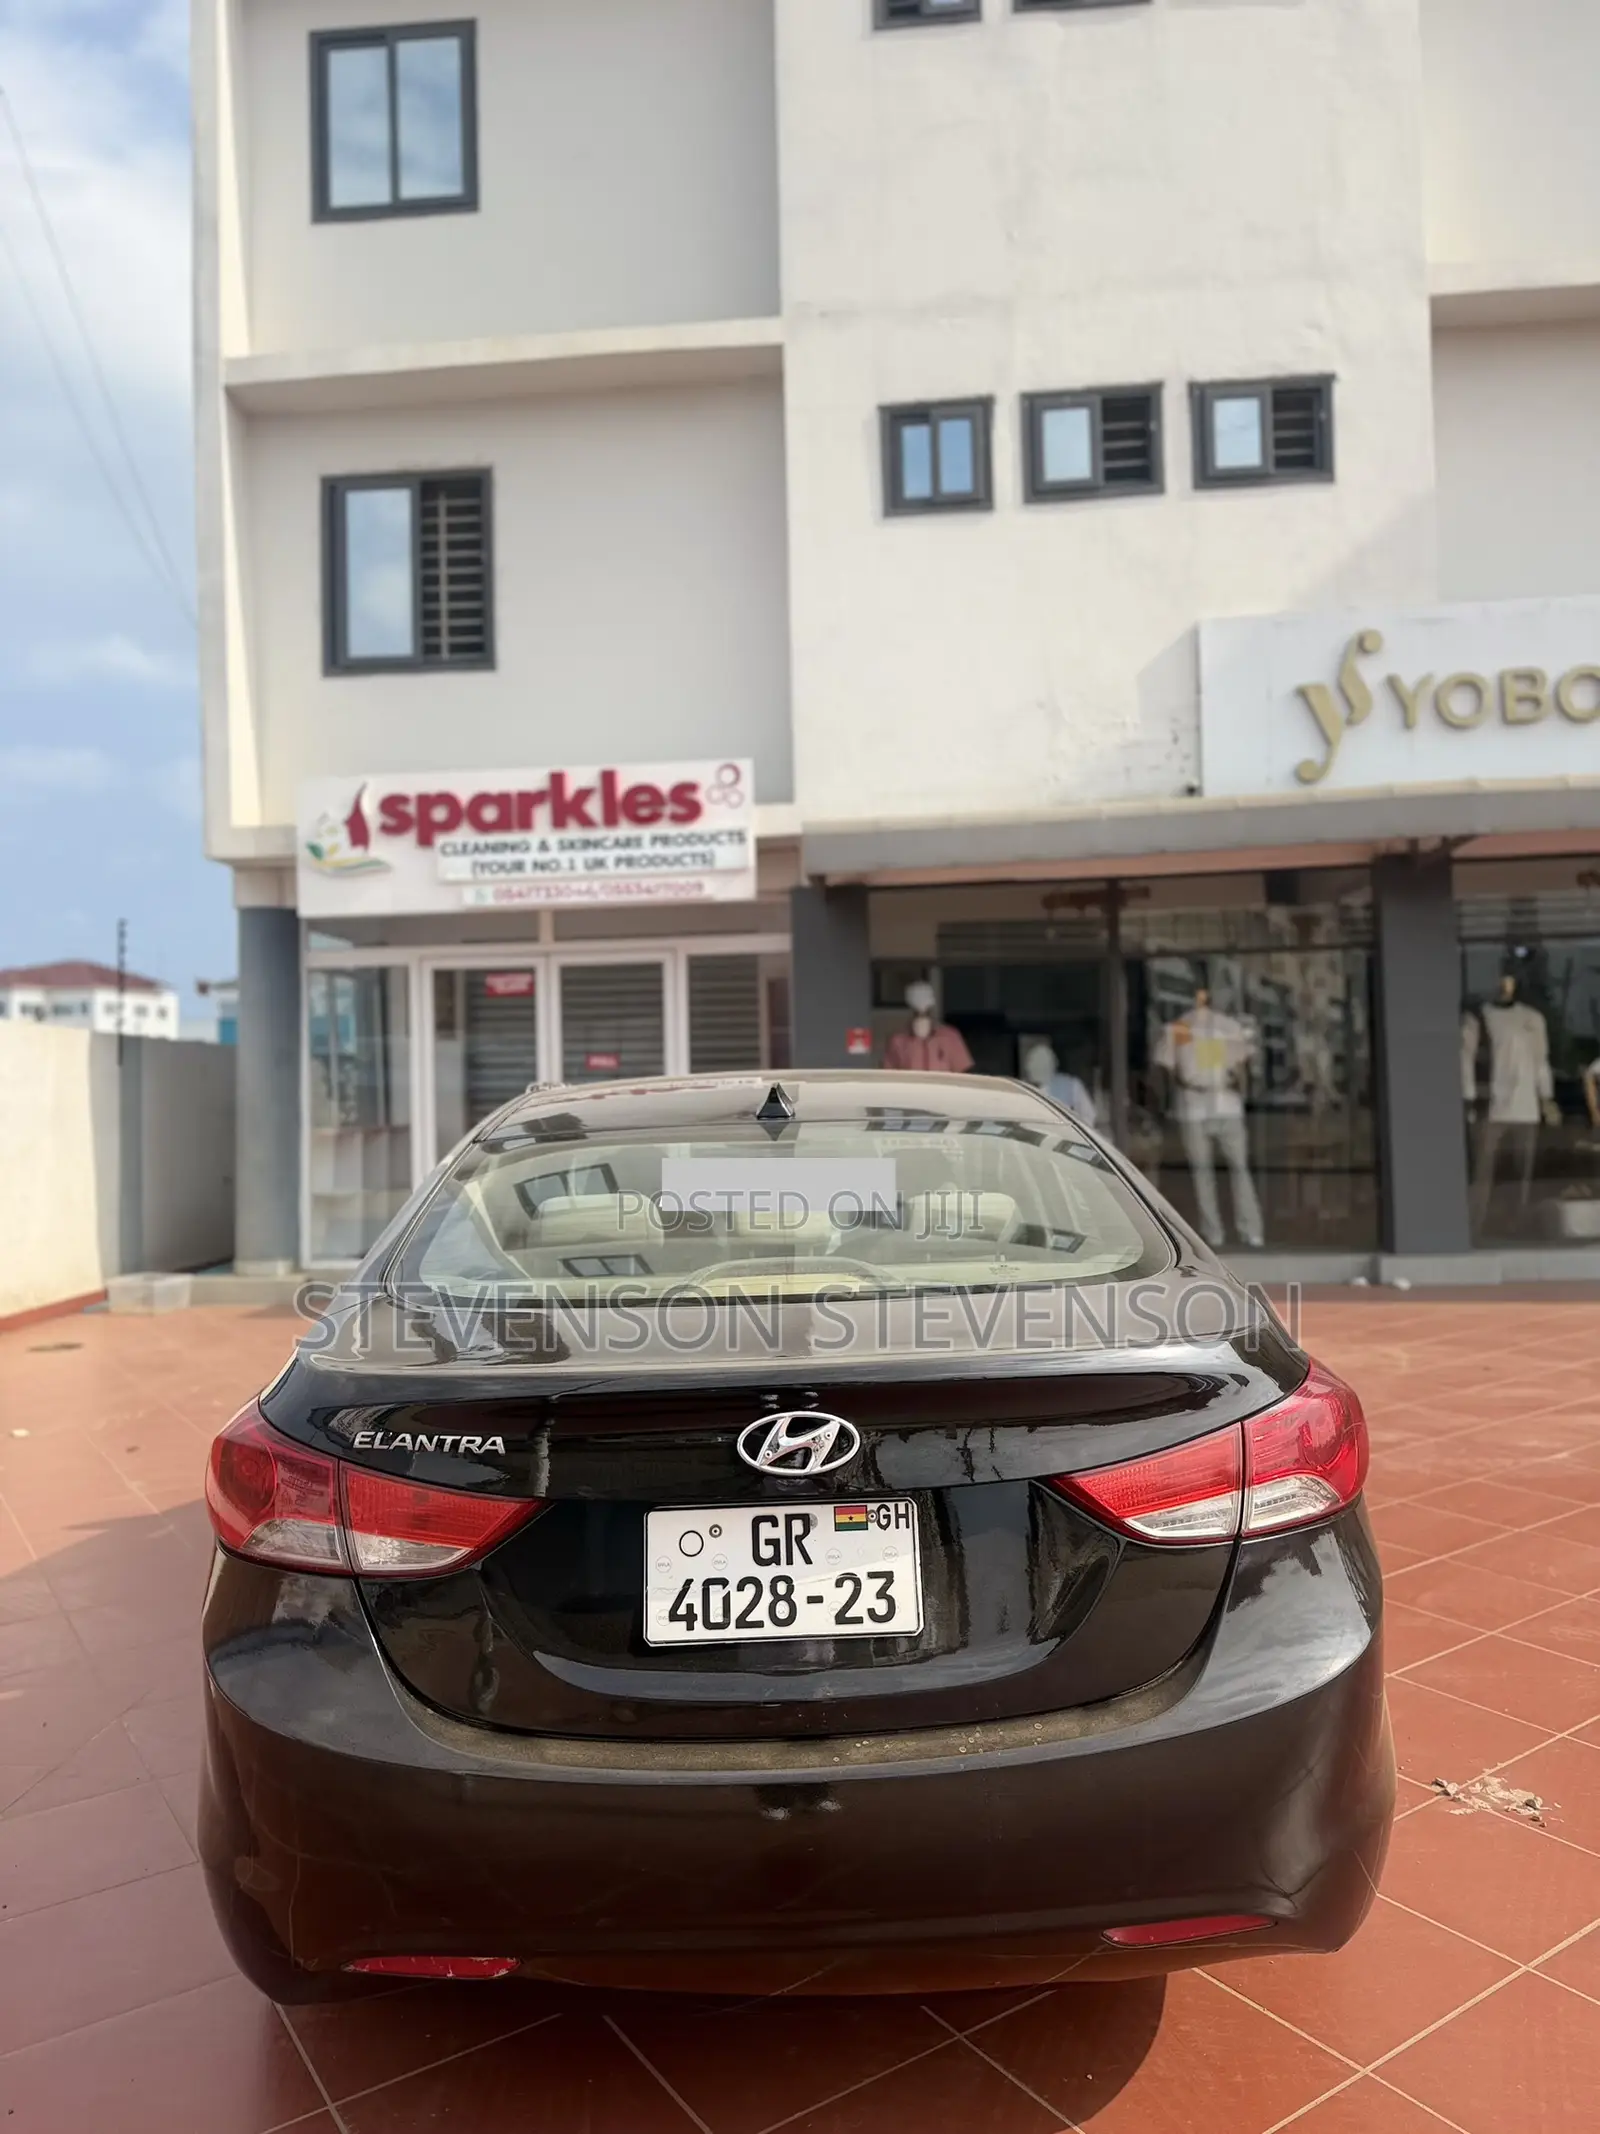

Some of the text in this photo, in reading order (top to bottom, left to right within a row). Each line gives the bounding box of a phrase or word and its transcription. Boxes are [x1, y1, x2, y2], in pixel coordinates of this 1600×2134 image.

[378, 769, 704, 847] sparkles
[439, 829, 746, 856] CLEANING & SKINCARE PRODUCTS
[584, 855, 606, 871] UK
[353, 1431, 506, 1456] ELANTRA
[876, 1503, 910, 1530] GH
[751, 1513, 813, 1566] GR
[668, 1570, 897, 1632] 4028-23
